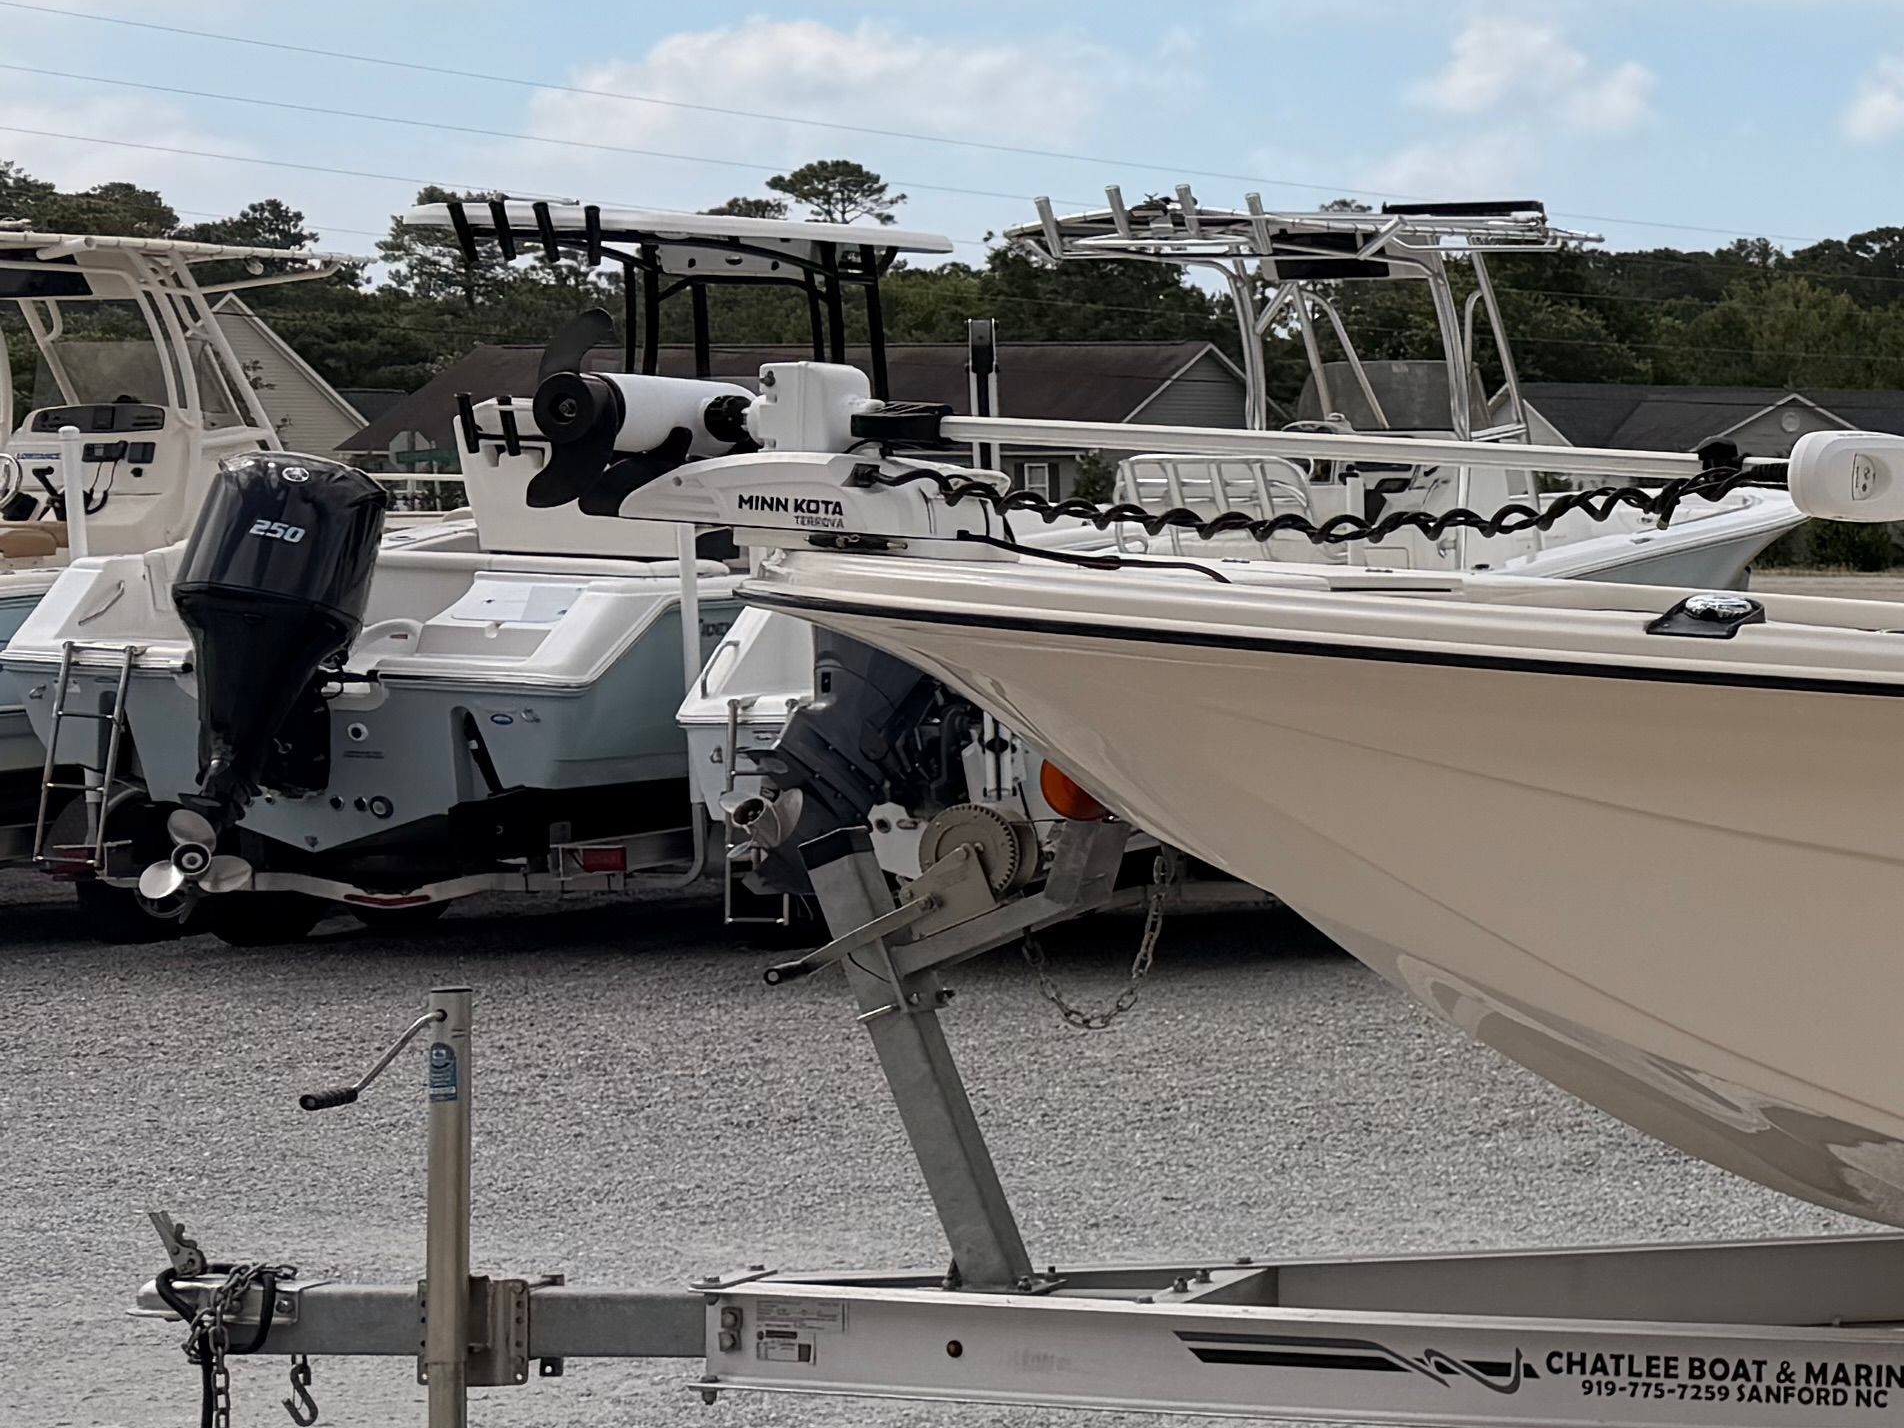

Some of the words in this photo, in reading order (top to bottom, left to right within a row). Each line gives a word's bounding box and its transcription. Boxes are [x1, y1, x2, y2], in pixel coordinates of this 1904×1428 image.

[738, 494, 789, 513] MINN
[793, 498, 844, 516] KOTA
[249, 519, 306, 543] 250
[1546, 1350, 1679, 1380] CHATLEE
[1688, 1357, 1768, 1384] BOAT
[1776, 1361, 1796, 1384] &
[1581, 1379, 1730, 1402] 919-775-7259
[1737, 1384, 1848, 1407] SANFORD
[1855, 1388, 1888, 1409] NC
